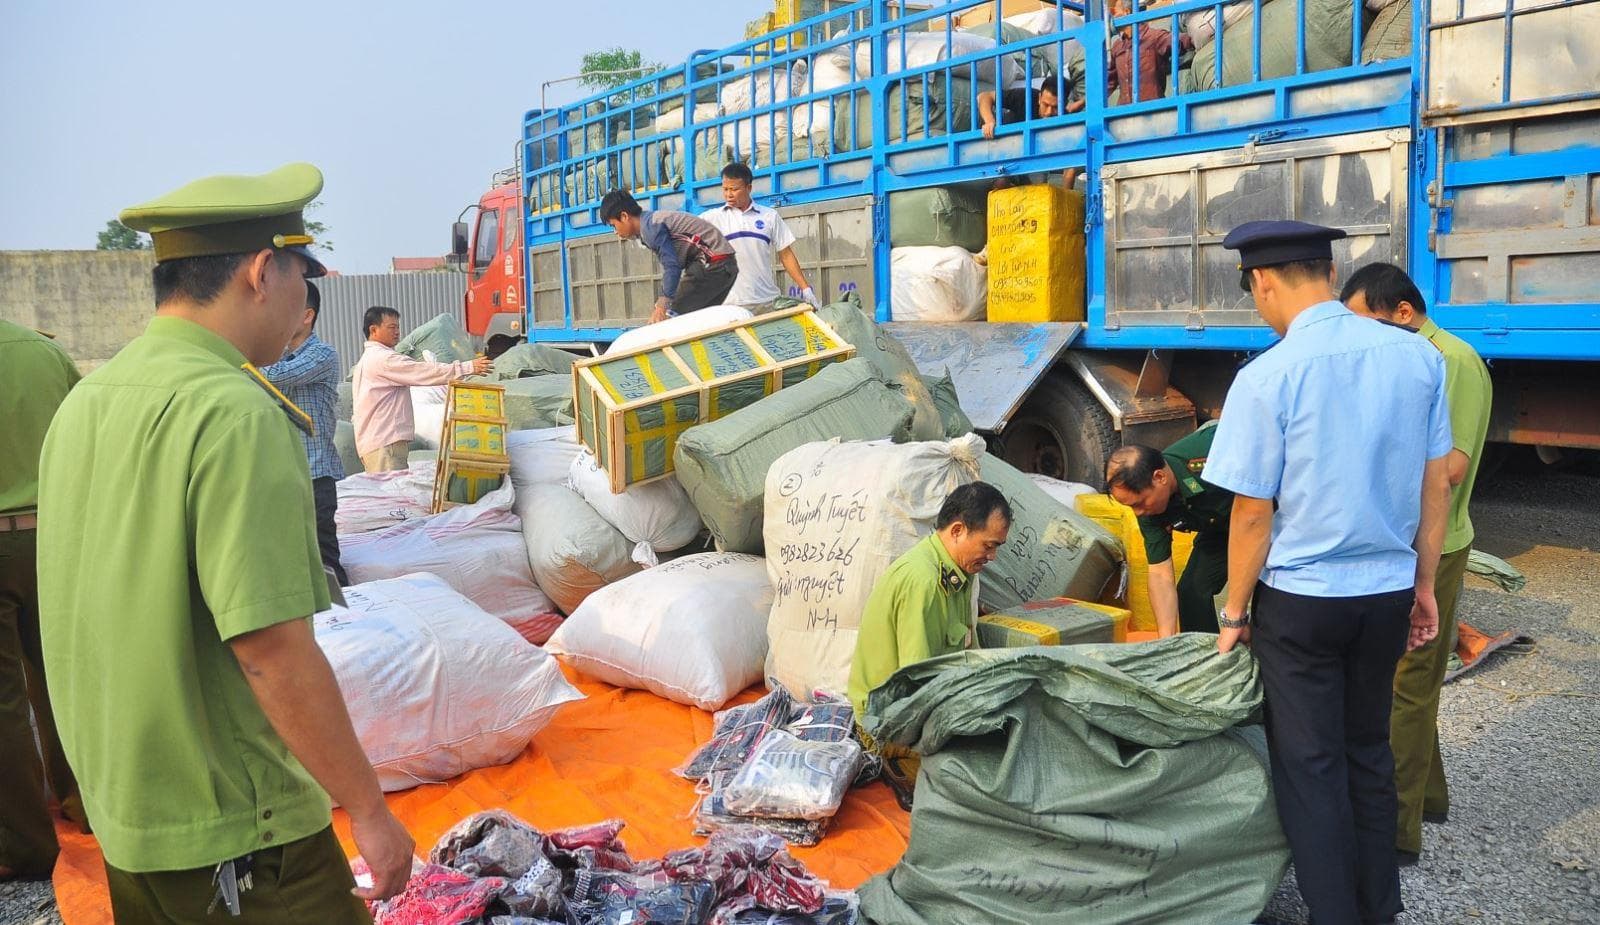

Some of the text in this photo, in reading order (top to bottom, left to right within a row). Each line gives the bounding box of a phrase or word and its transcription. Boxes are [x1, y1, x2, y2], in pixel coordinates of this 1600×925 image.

[786, 488, 868, 535] Quỳnh Tuyết
[780, 537, 860, 566] 0982823626
